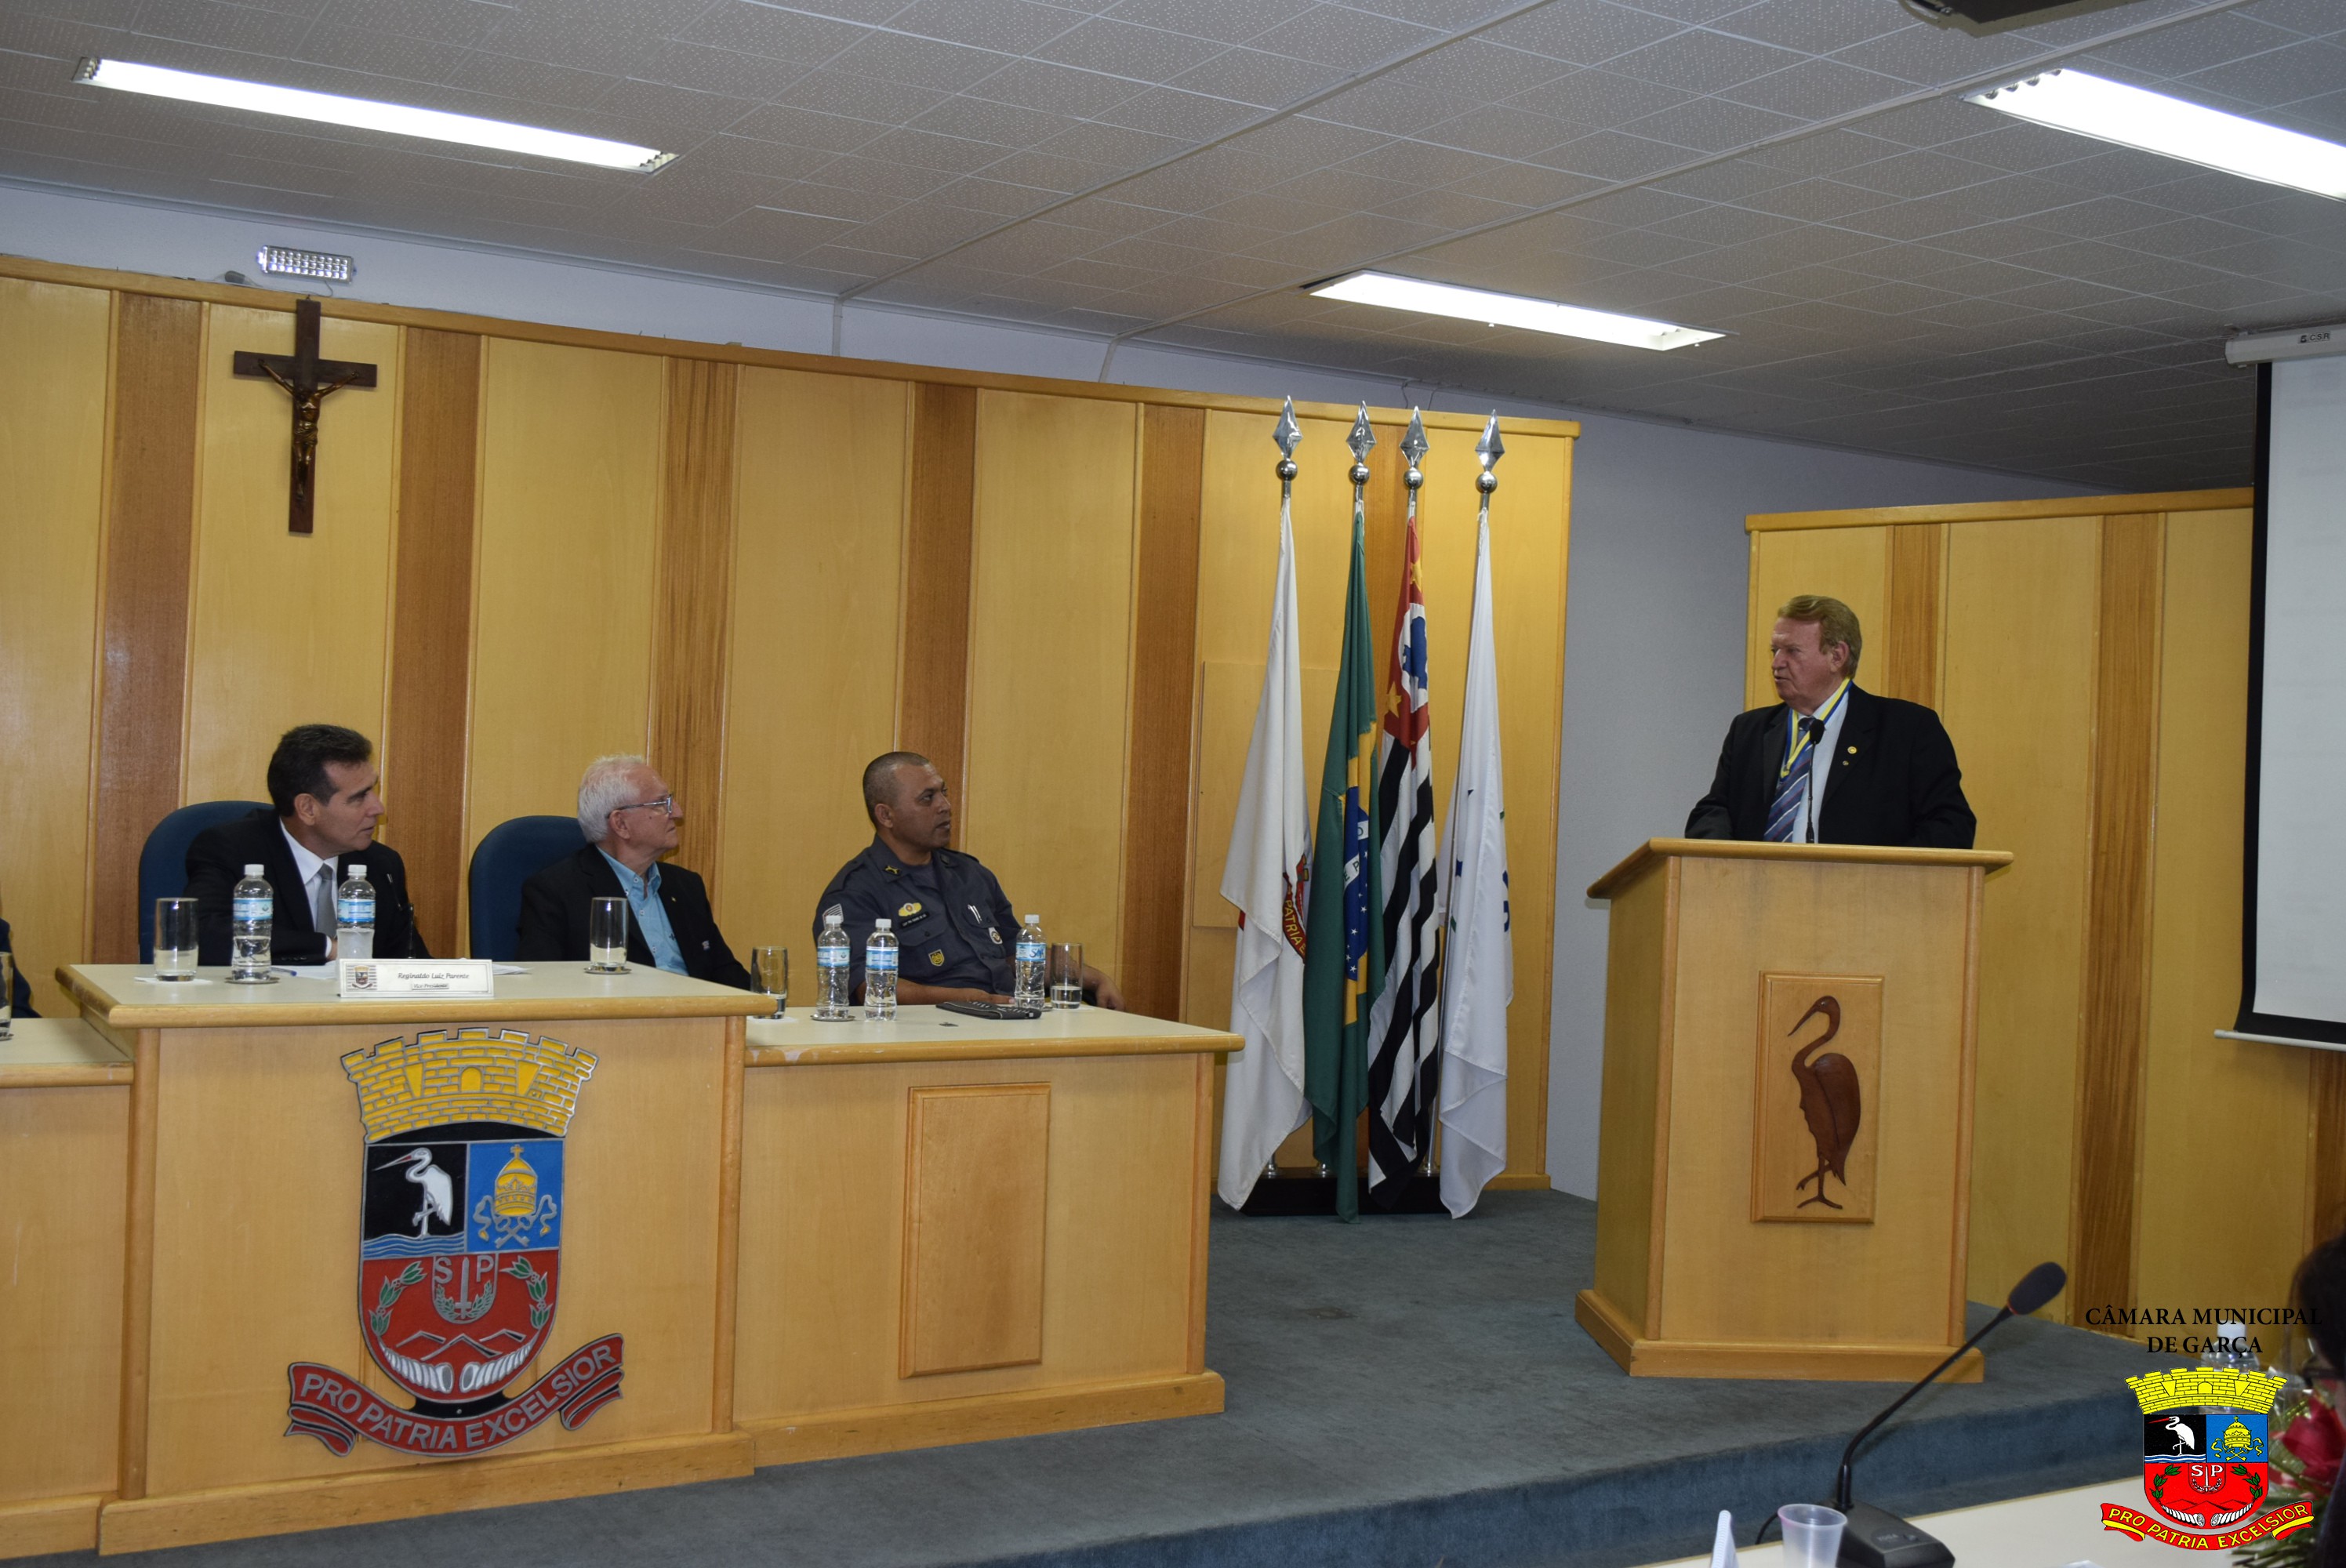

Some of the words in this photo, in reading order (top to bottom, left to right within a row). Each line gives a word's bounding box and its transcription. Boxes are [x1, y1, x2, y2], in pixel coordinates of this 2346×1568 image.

[1286, 899, 1303, 946] PATRIA
[300, 1373, 362, 1414] PRO
[357, 1403, 457, 1449] PATRIA
[465, 1345, 616, 1448] EXCELSIOR
